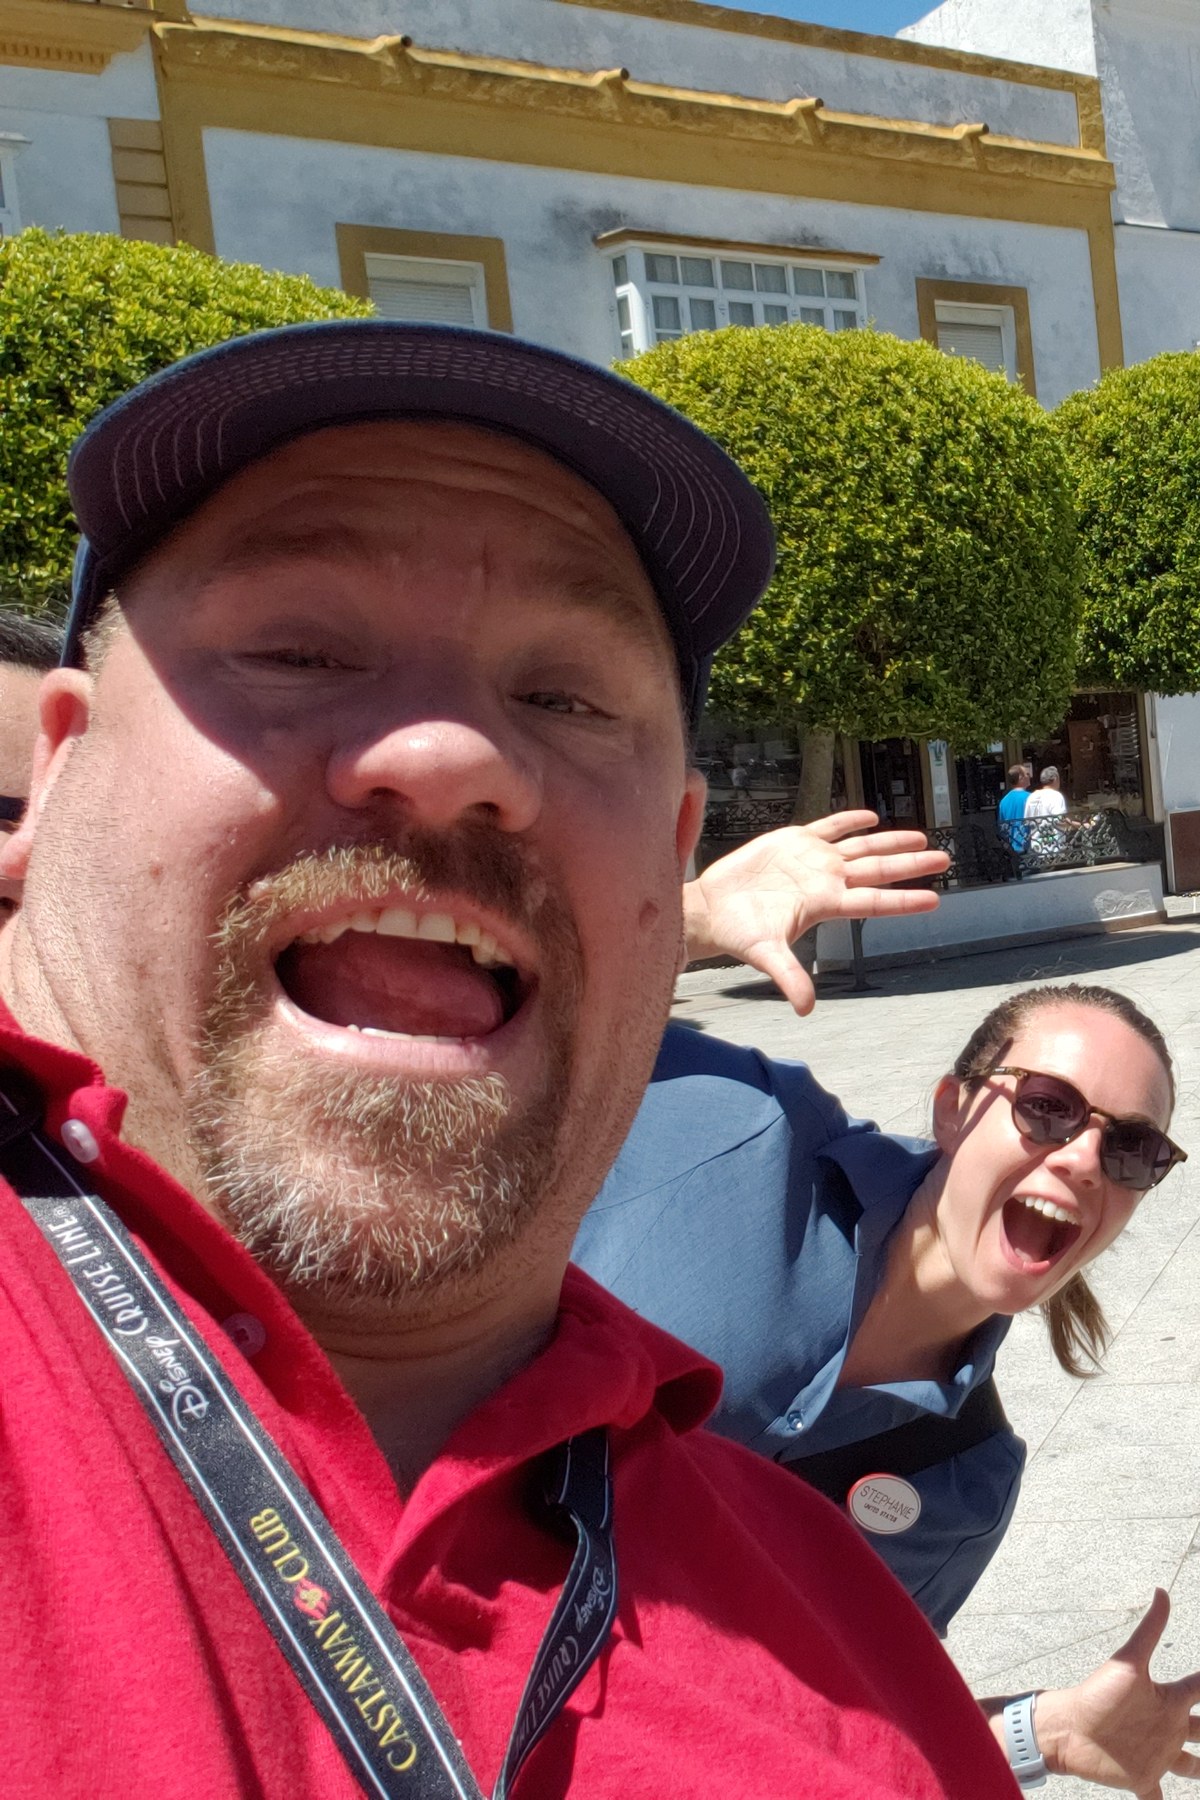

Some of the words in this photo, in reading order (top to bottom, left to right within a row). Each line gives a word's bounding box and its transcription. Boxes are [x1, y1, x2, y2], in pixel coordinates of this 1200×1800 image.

[83, 1262, 148, 1335] CRUISE
[860, 1485, 915, 1520] STEPHANIE
[250, 1507, 310, 1584] CLUB
[308, 1611, 417, 1772] CASTAWAY
[537, 1635, 579, 1711] CRUISE
